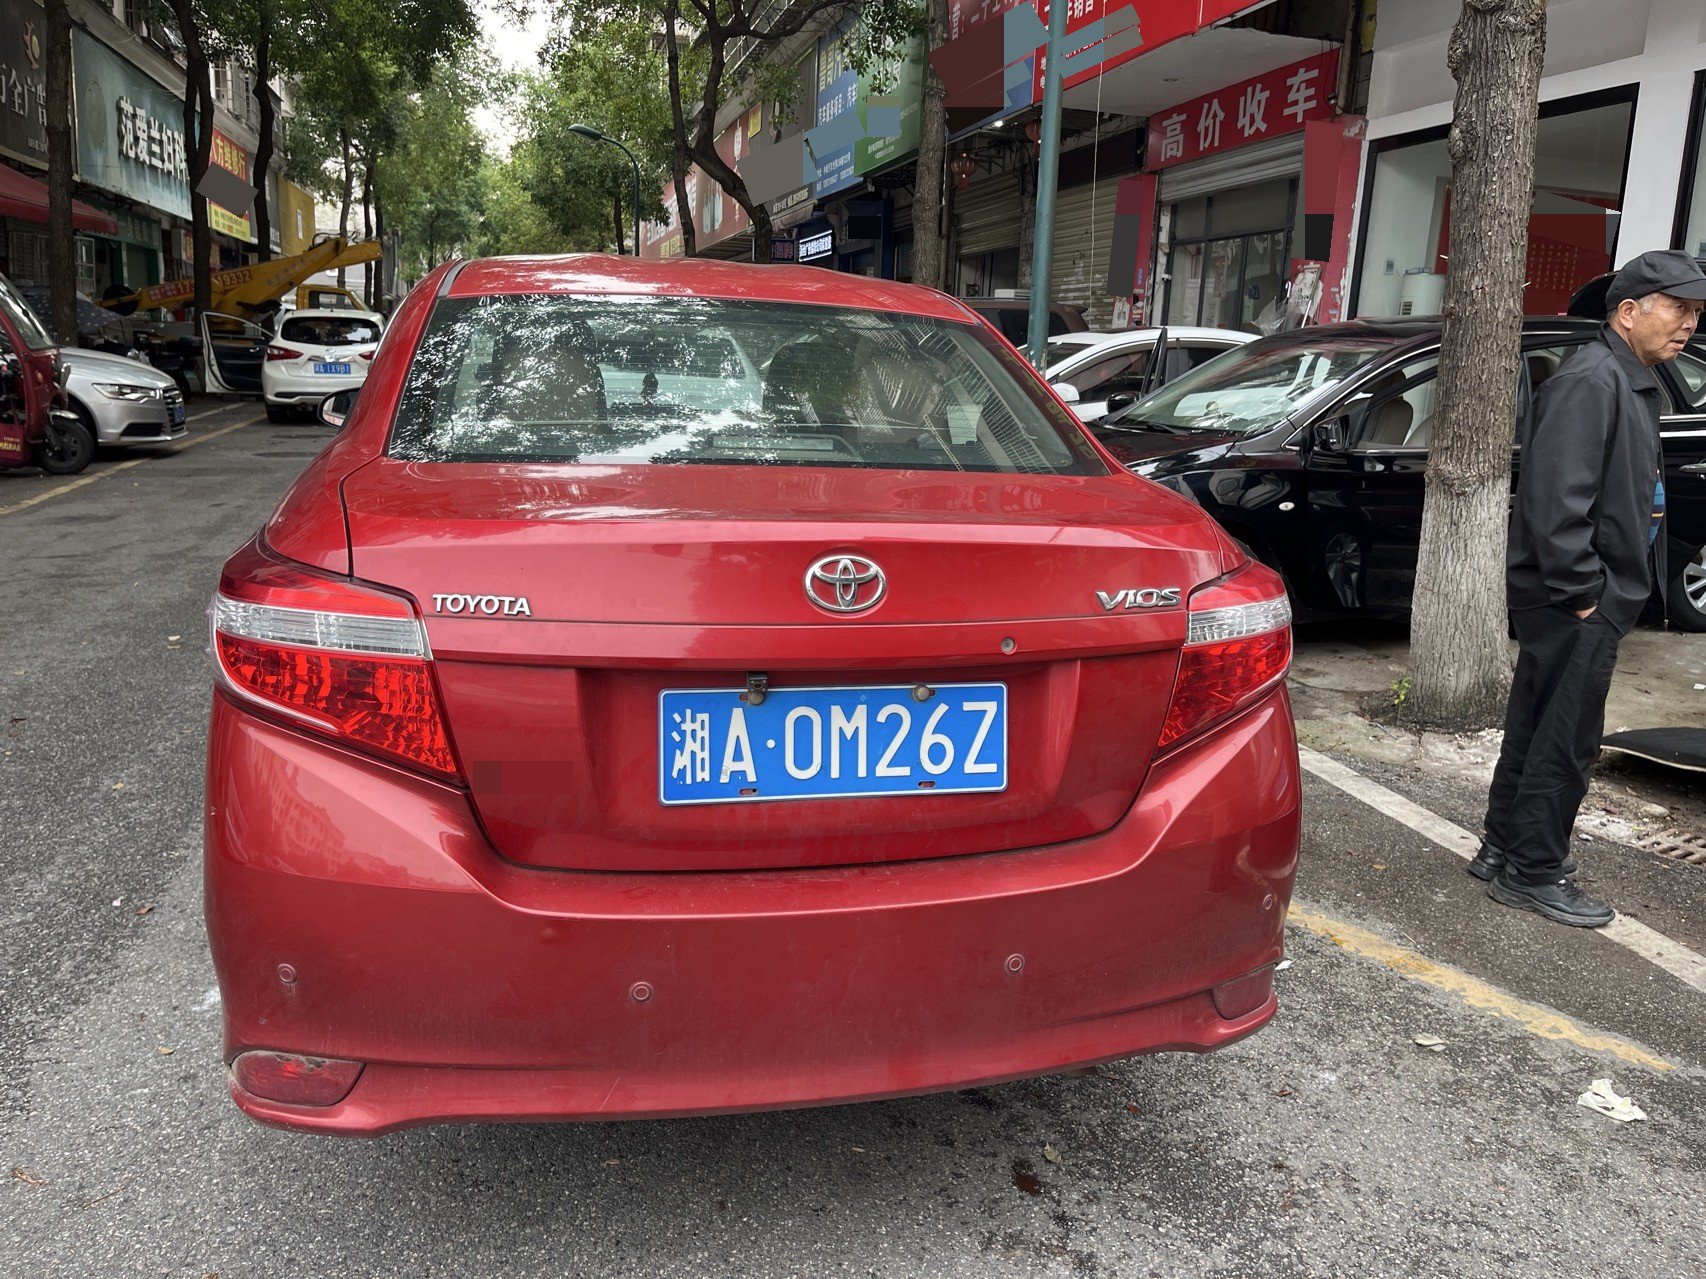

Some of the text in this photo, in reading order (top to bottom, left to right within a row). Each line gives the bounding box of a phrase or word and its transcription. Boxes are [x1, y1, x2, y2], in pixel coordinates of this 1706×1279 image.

[1160, 67, 1319, 162] 高价收车
[432, 594, 532, 616] TOYOTA
[1096, 587, 1181, 611] VIOS
